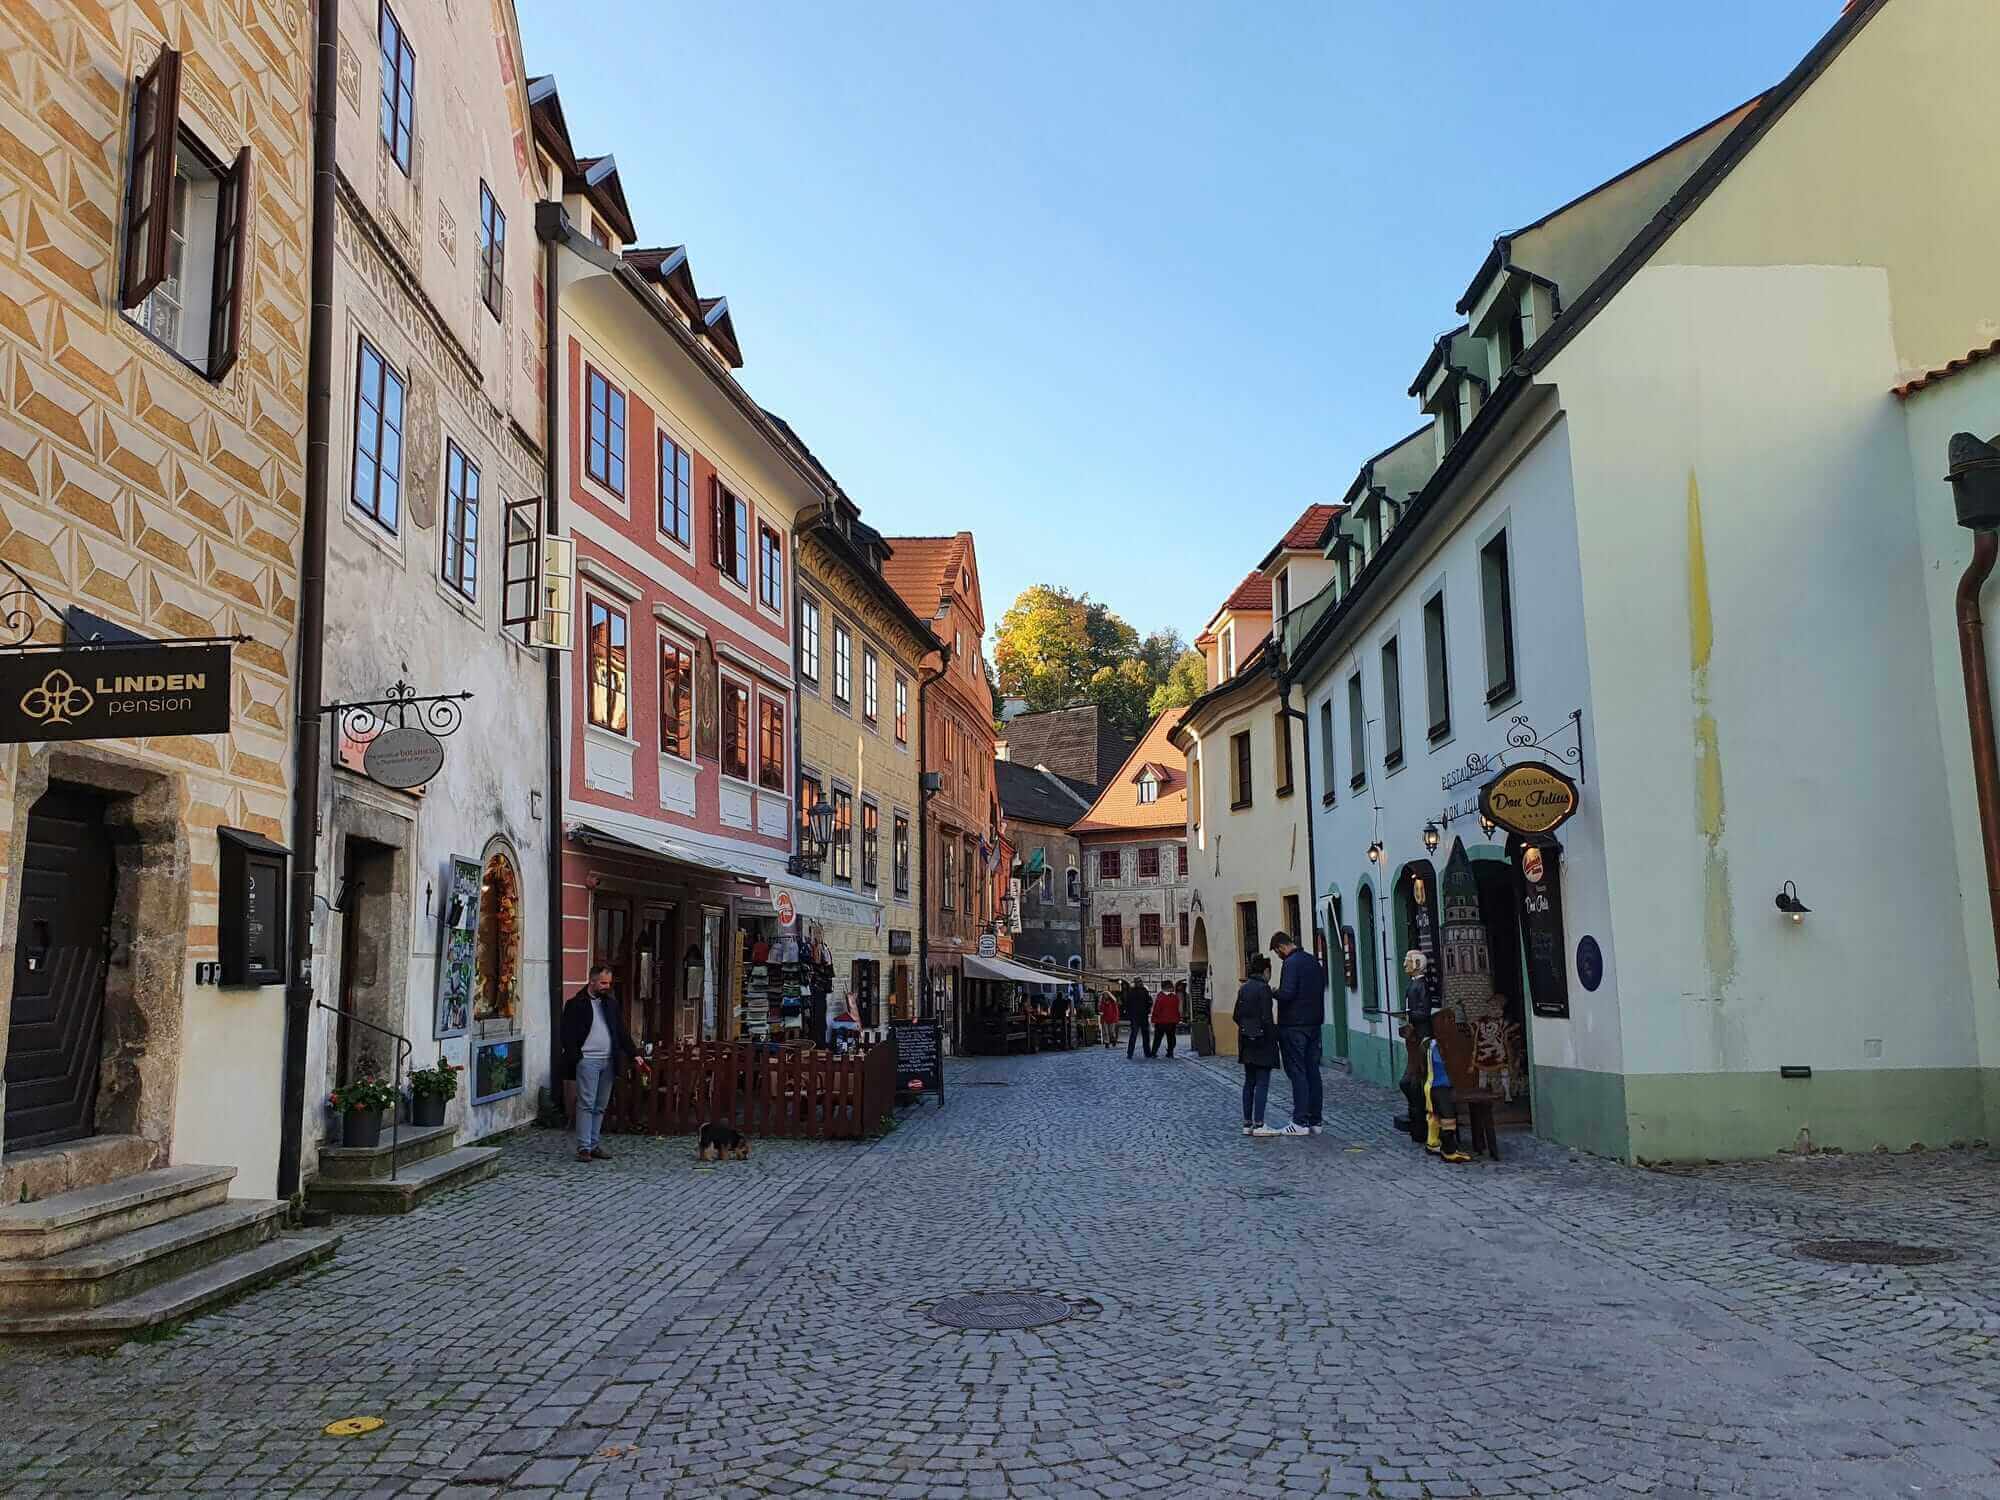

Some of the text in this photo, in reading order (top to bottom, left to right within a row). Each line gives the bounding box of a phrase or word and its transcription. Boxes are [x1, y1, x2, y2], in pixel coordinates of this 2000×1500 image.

[95, 673, 206, 694] LINDEN
[108, 695, 192, 716] pension
[1503, 778, 1555, 788] RESTAURANT
[1491, 790, 1569, 809] Don Julius
